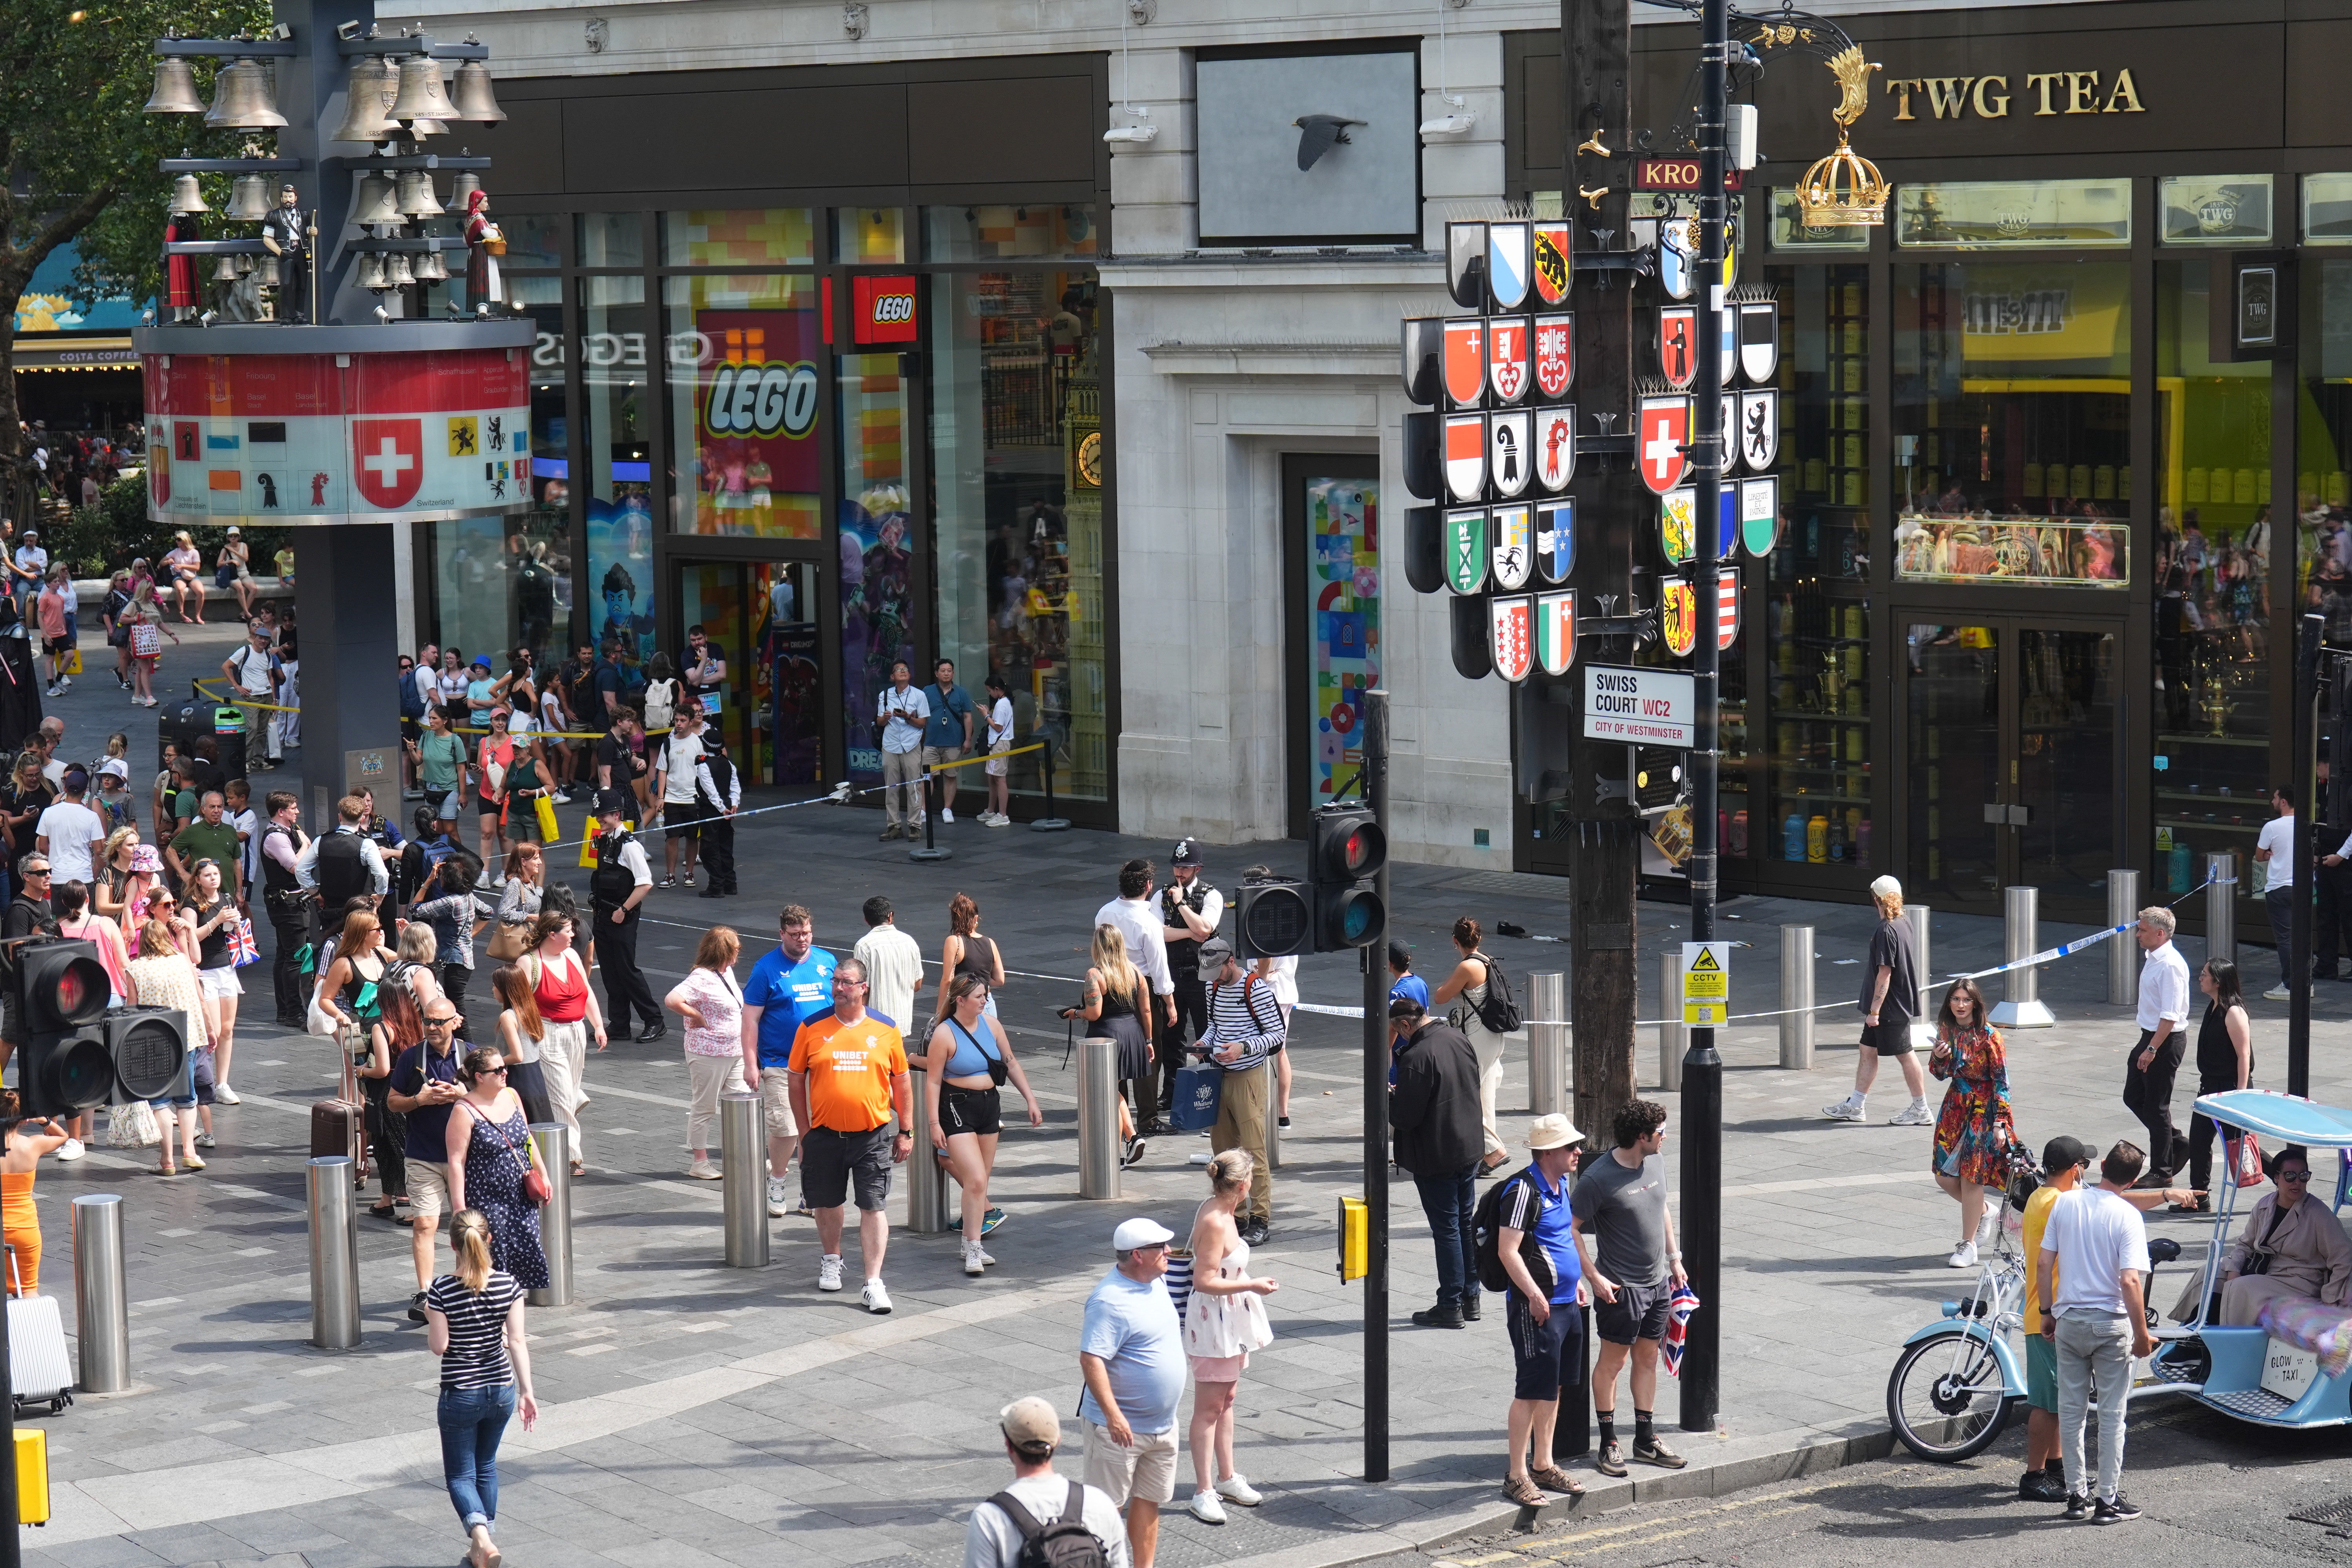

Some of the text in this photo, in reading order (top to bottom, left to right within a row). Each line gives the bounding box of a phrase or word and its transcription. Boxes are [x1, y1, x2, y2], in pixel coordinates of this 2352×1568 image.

[1886, 69, 2145, 120] TWG TEA
[1998, 212, 2028, 225] TWG
[2200, 208, 2233, 220] TWG
[874, 295, 914, 322] LEGO
[2248, 303, 2267, 316] TWG
[60, 351, 140, 361] COSTA COFFEE
[246, 372, 275, 381] Fribourg
[708, 365, 818, 435] LEGO
[1653, 399, 1675, 408] 1291-1991
[487, 434, 493, 445] V
[501, 433, 506, 444] R
[1746, 437, 1752, 446] V
[1766, 436, 1771, 446] R
[416, 498, 454, 507] Switzerland
[1749, 506, 1767, 515] PATRIE
[1995, 548, 2027, 559] TWG
[1597, 673, 1637, 693] SWISS
[1596, 694, 1670, 717] COURT WC2
[1595, 721, 1682, 740] CITY OF WESTMINSTER
[2102, 929, 2114, 939] POLICE
[2071, 942, 2082, 951] CROSS
[2082, 939, 2090, 948] NOT
[2043, 949, 2055, 959] POLICE
[791, 982, 823, 992] UNIBET
[1336, 1006, 1347, 1014] LINE
[1347, 1007, 1364, 1017] POLICE
[832, 1050, 869, 1060] UNIBET
[1193, 1098, 1213, 1107] Whittard
[1648, 1180, 1659, 1189] JEANS
[2271, 1355, 2292, 1368] GLOW
[2283, 1368, 2298, 1382] TAXI
